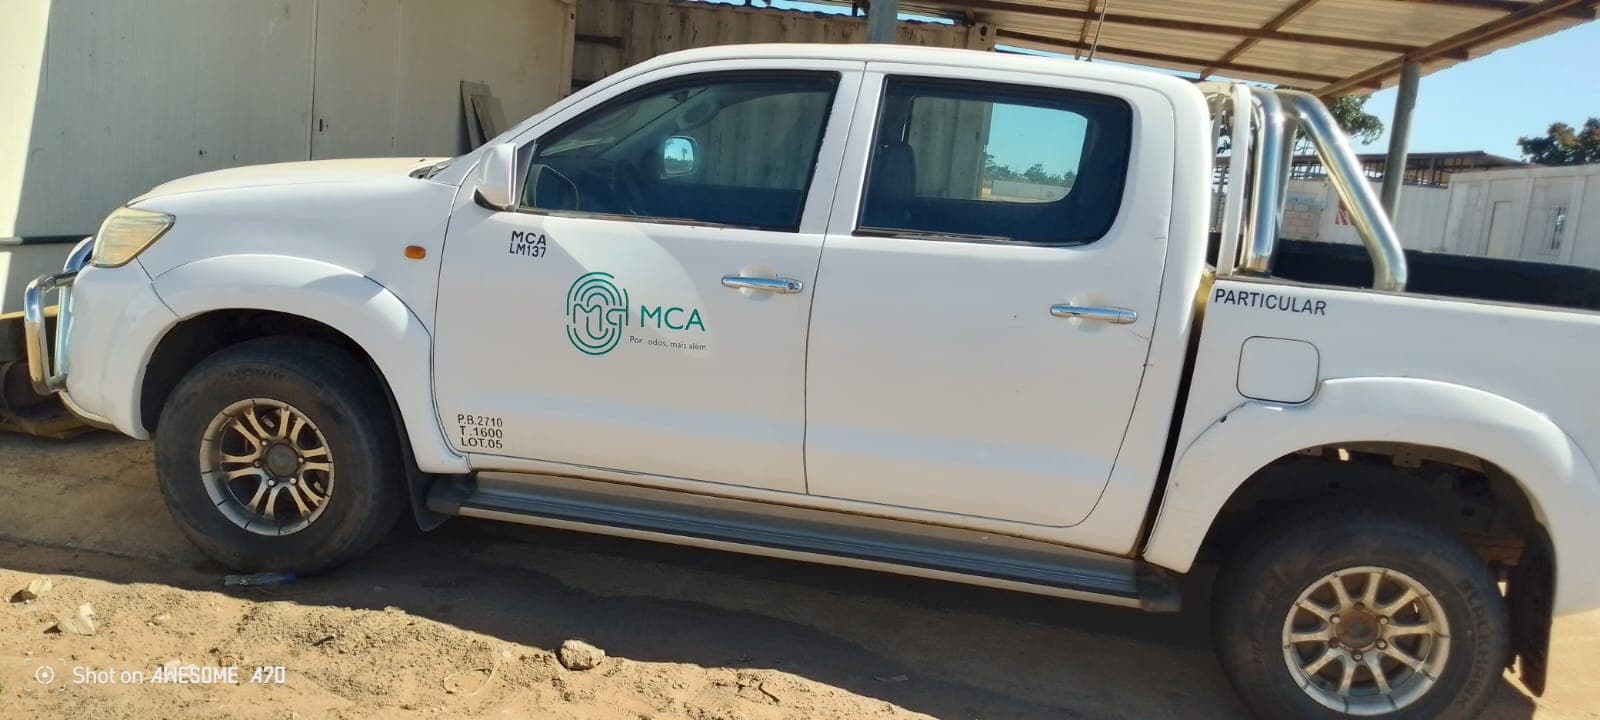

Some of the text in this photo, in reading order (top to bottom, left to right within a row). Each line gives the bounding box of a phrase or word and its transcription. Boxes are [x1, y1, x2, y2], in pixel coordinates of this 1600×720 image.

[511, 230, 546, 247] MCA
[509, 242, 546, 258] LM137
[1214, 288, 1327, 316] PARTICULAR
[640, 304, 706, 332] MCA
[457, 413, 503, 427] P.B.2710
[461, 437, 503, 449] LOT.05
